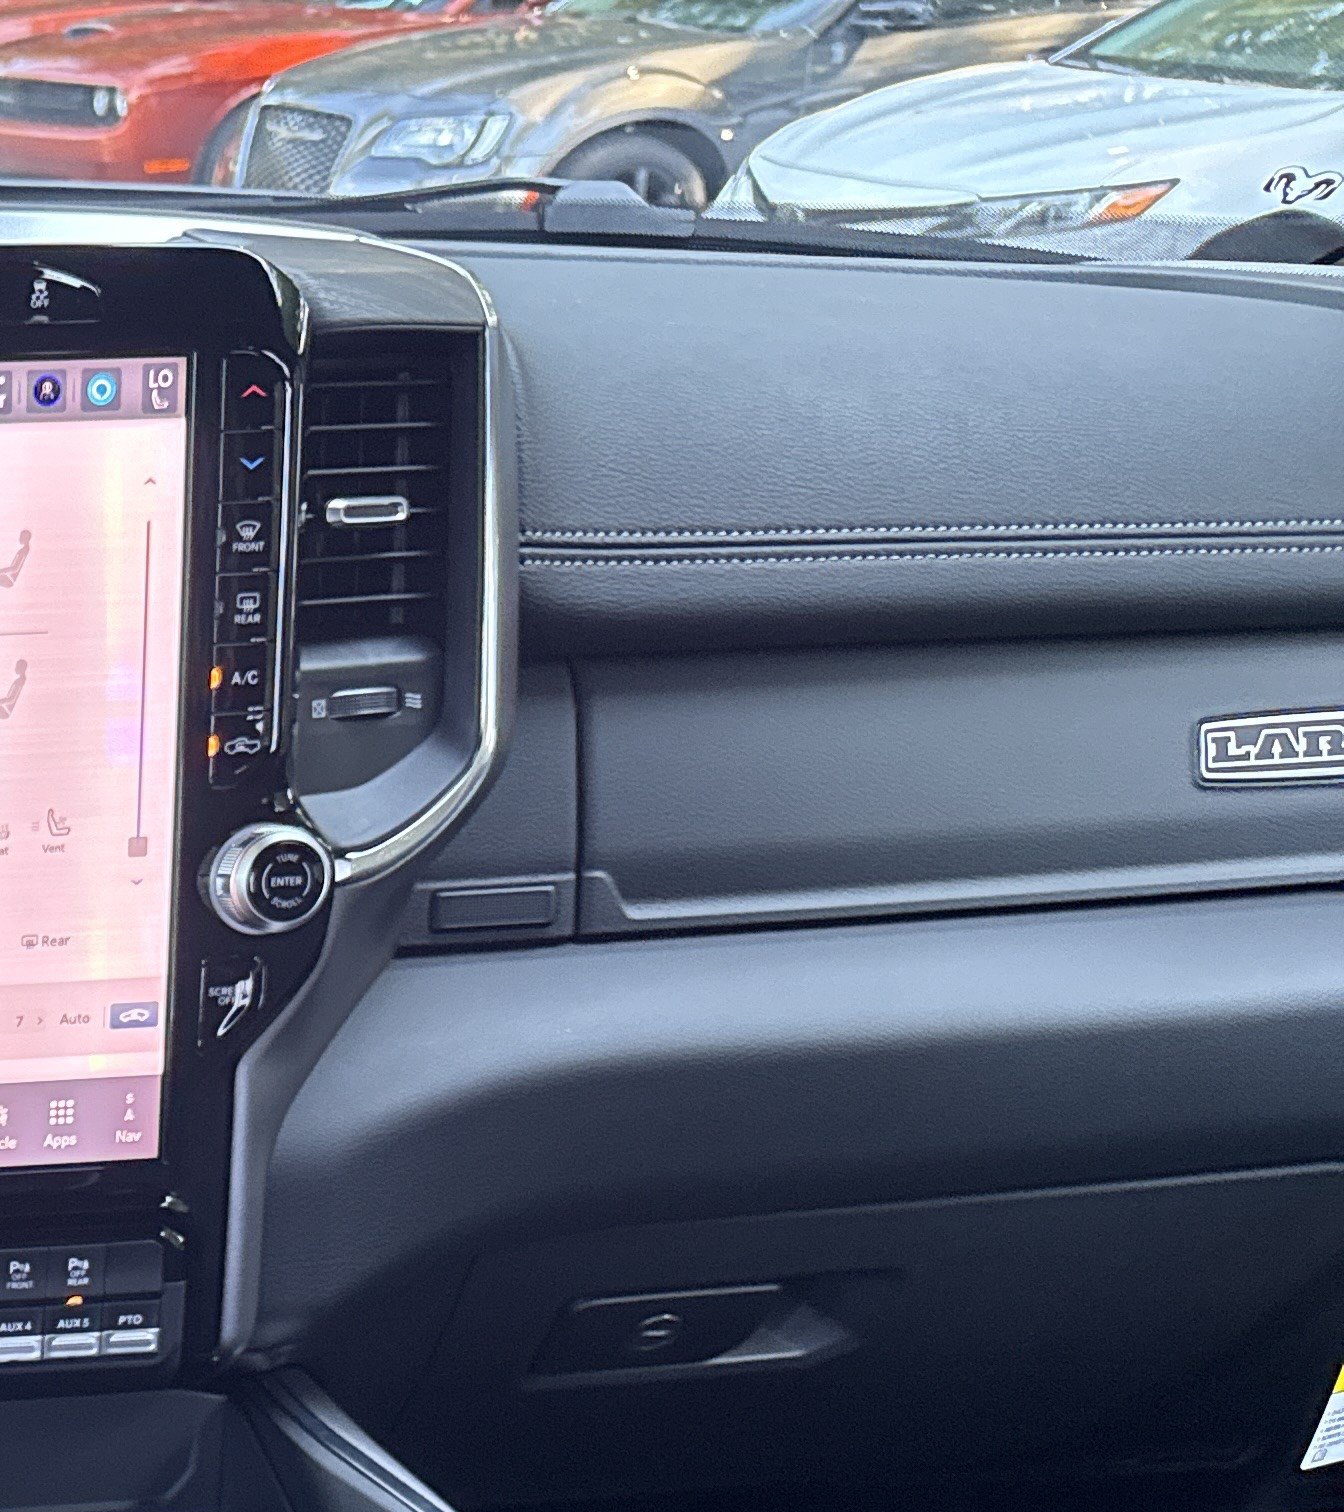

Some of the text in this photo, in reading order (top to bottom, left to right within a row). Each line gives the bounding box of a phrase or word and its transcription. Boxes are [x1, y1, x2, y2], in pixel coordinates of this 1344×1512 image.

[30, 299, 50, 309] OFF
[148, 368, 174, 388] LO
[232, 541, 265, 553] FRONT
[234, 614, 261, 625] REAR
[231, 671, 259, 686] A/C
[42, 843, 66, 855] Vent
[270, 876, 303, 888] ENTER
[42, 935, 71, 948] Rear
[15, 1016, 24, 1028] 7
[59, 1012, 91, 1026] Auto
[43, 1134, 77, 1150] Apps
[115, 1129, 142, 1144] Nav
[25, 1320, 32, 1331] 4
[56, 1317, 90, 1329] AUX 5
[117, 1314, 144, 1326] PTO
